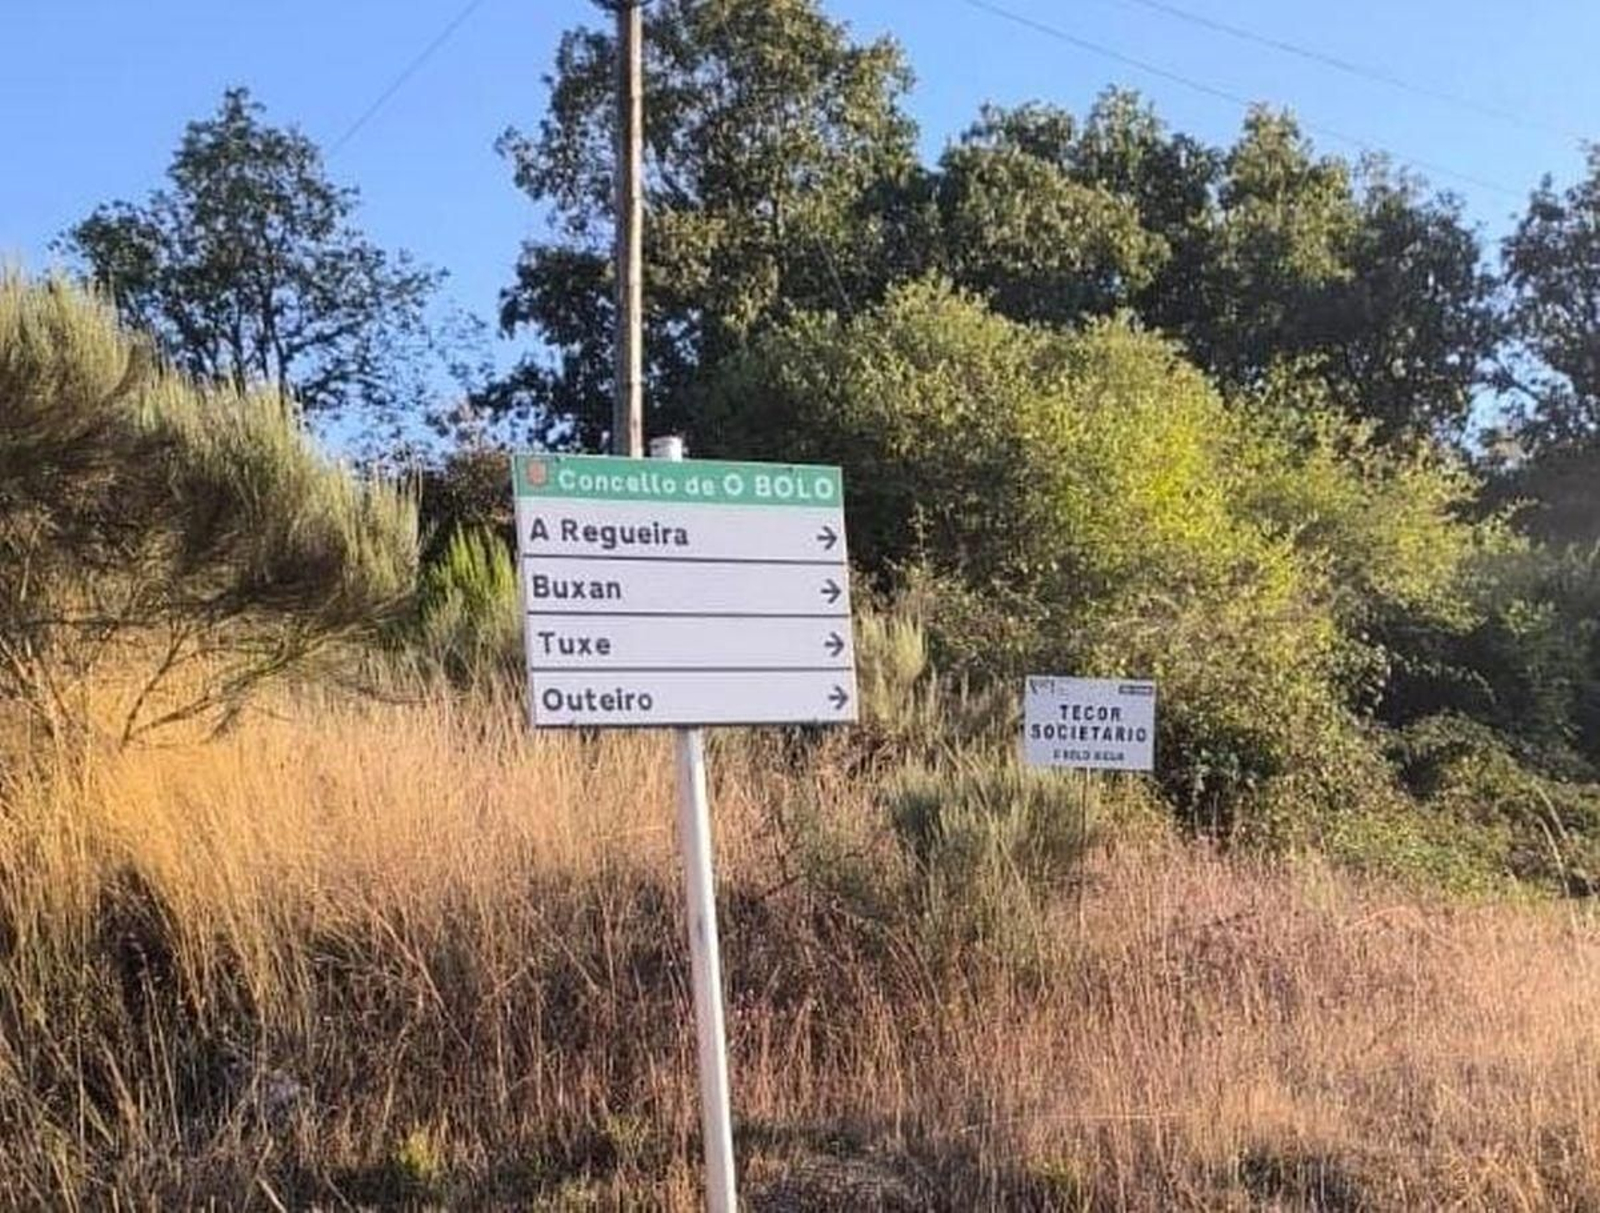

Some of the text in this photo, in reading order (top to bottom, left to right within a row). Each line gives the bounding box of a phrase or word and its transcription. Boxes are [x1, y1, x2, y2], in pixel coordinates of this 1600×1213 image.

[557, 469, 834, 499] Concello de O BOLO
[530, 518, 690, 549] A Regueira
[532, 575, 622, 599] Buxan
[538, 632, 611, 655] Tuxe
[542, 688, 653, 711] Outeiro
[1059, 704, 1122, 721] TECOR
[1030, 723, 1147, 742] SOCIETARIO
